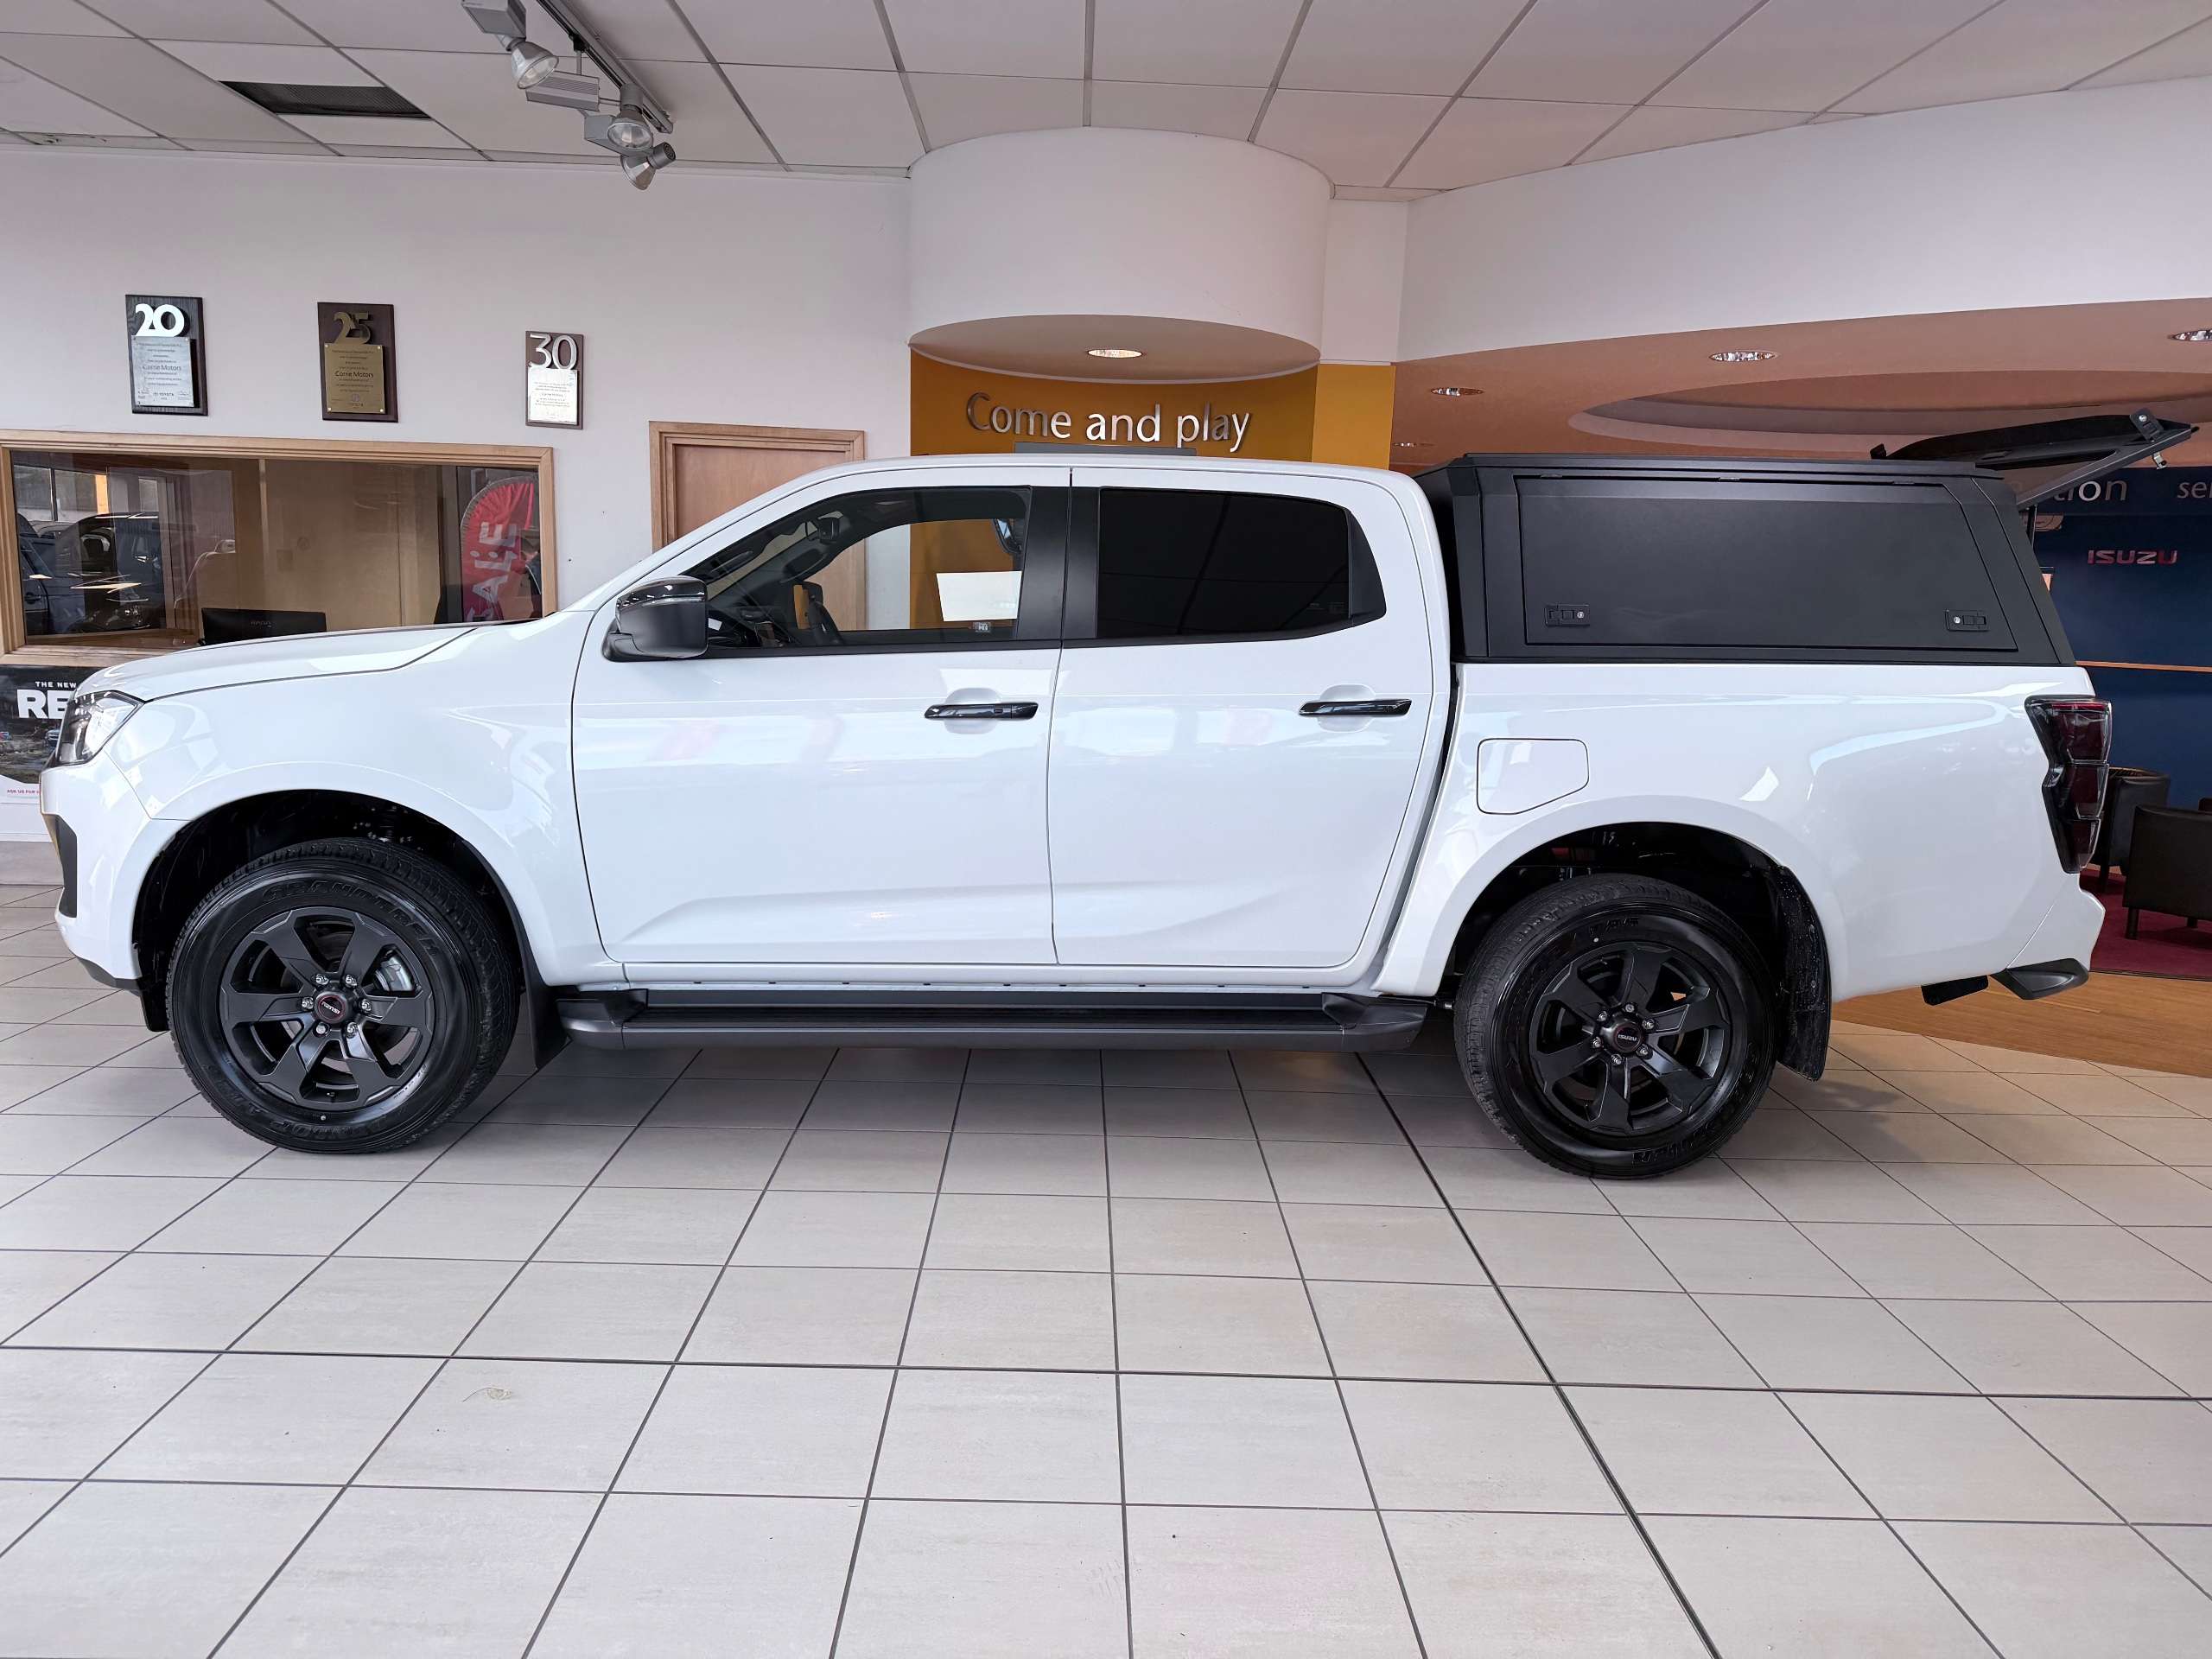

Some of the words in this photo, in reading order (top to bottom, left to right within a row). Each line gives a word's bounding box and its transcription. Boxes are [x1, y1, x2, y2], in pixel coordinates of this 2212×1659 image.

[135, 302, 185, 336] 20
[334, 311, 371, 344] 25
[528, 333, 577, 370] 30
[966, 391, 1071, 440] Come
[1086, 403, 1160, 442] and
[1176, 402, 1251, 453] play
[2087, 550, 2178, 565] ISUZU
[1618, 1033, 1637, 1042] ISUZU
